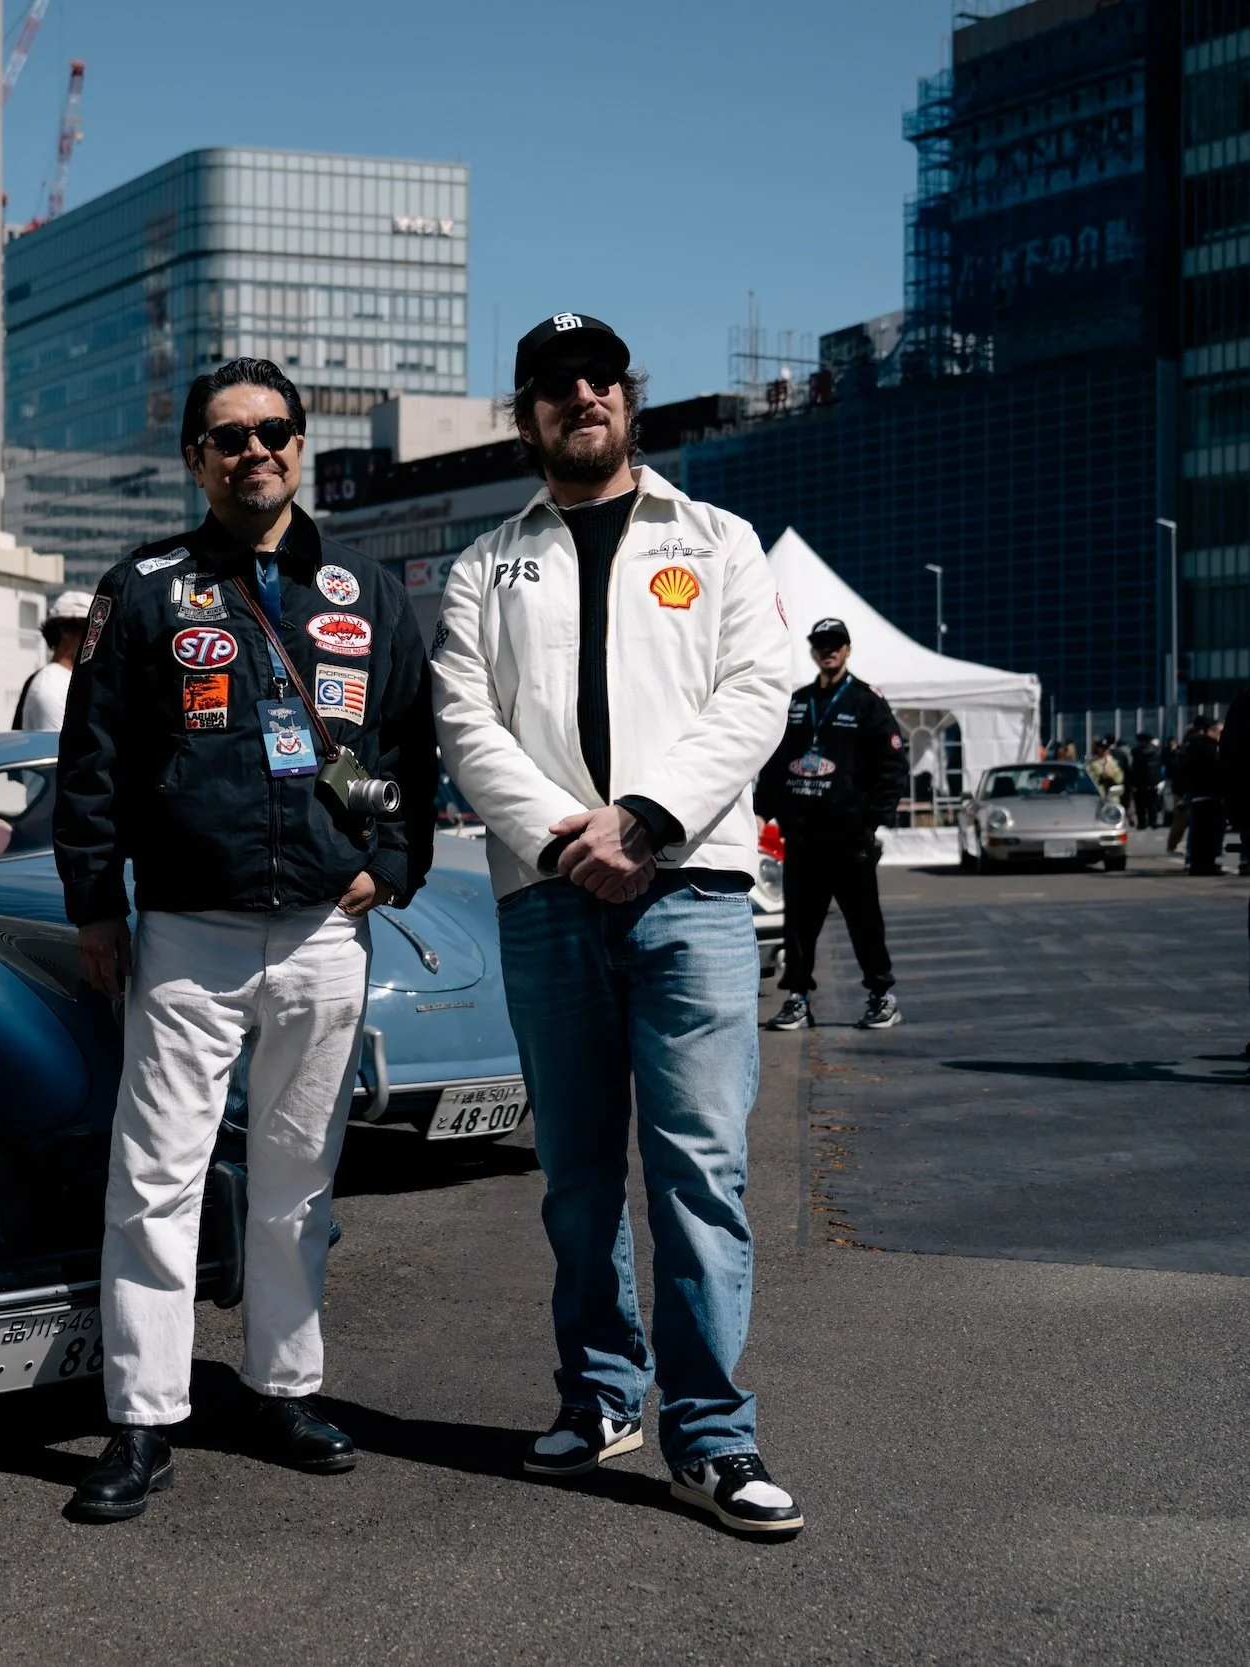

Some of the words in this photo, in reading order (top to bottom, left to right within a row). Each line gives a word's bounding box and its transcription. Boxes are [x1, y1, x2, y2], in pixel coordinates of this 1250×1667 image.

[178, 632, 233, 665] STP
[318, 669, 367, 683] PORSCHE
[186, 711, 225, 721] LAGUNA
[200, 719, 225, 728] SECA
[450, 1103, 520, 1135] 48-00
